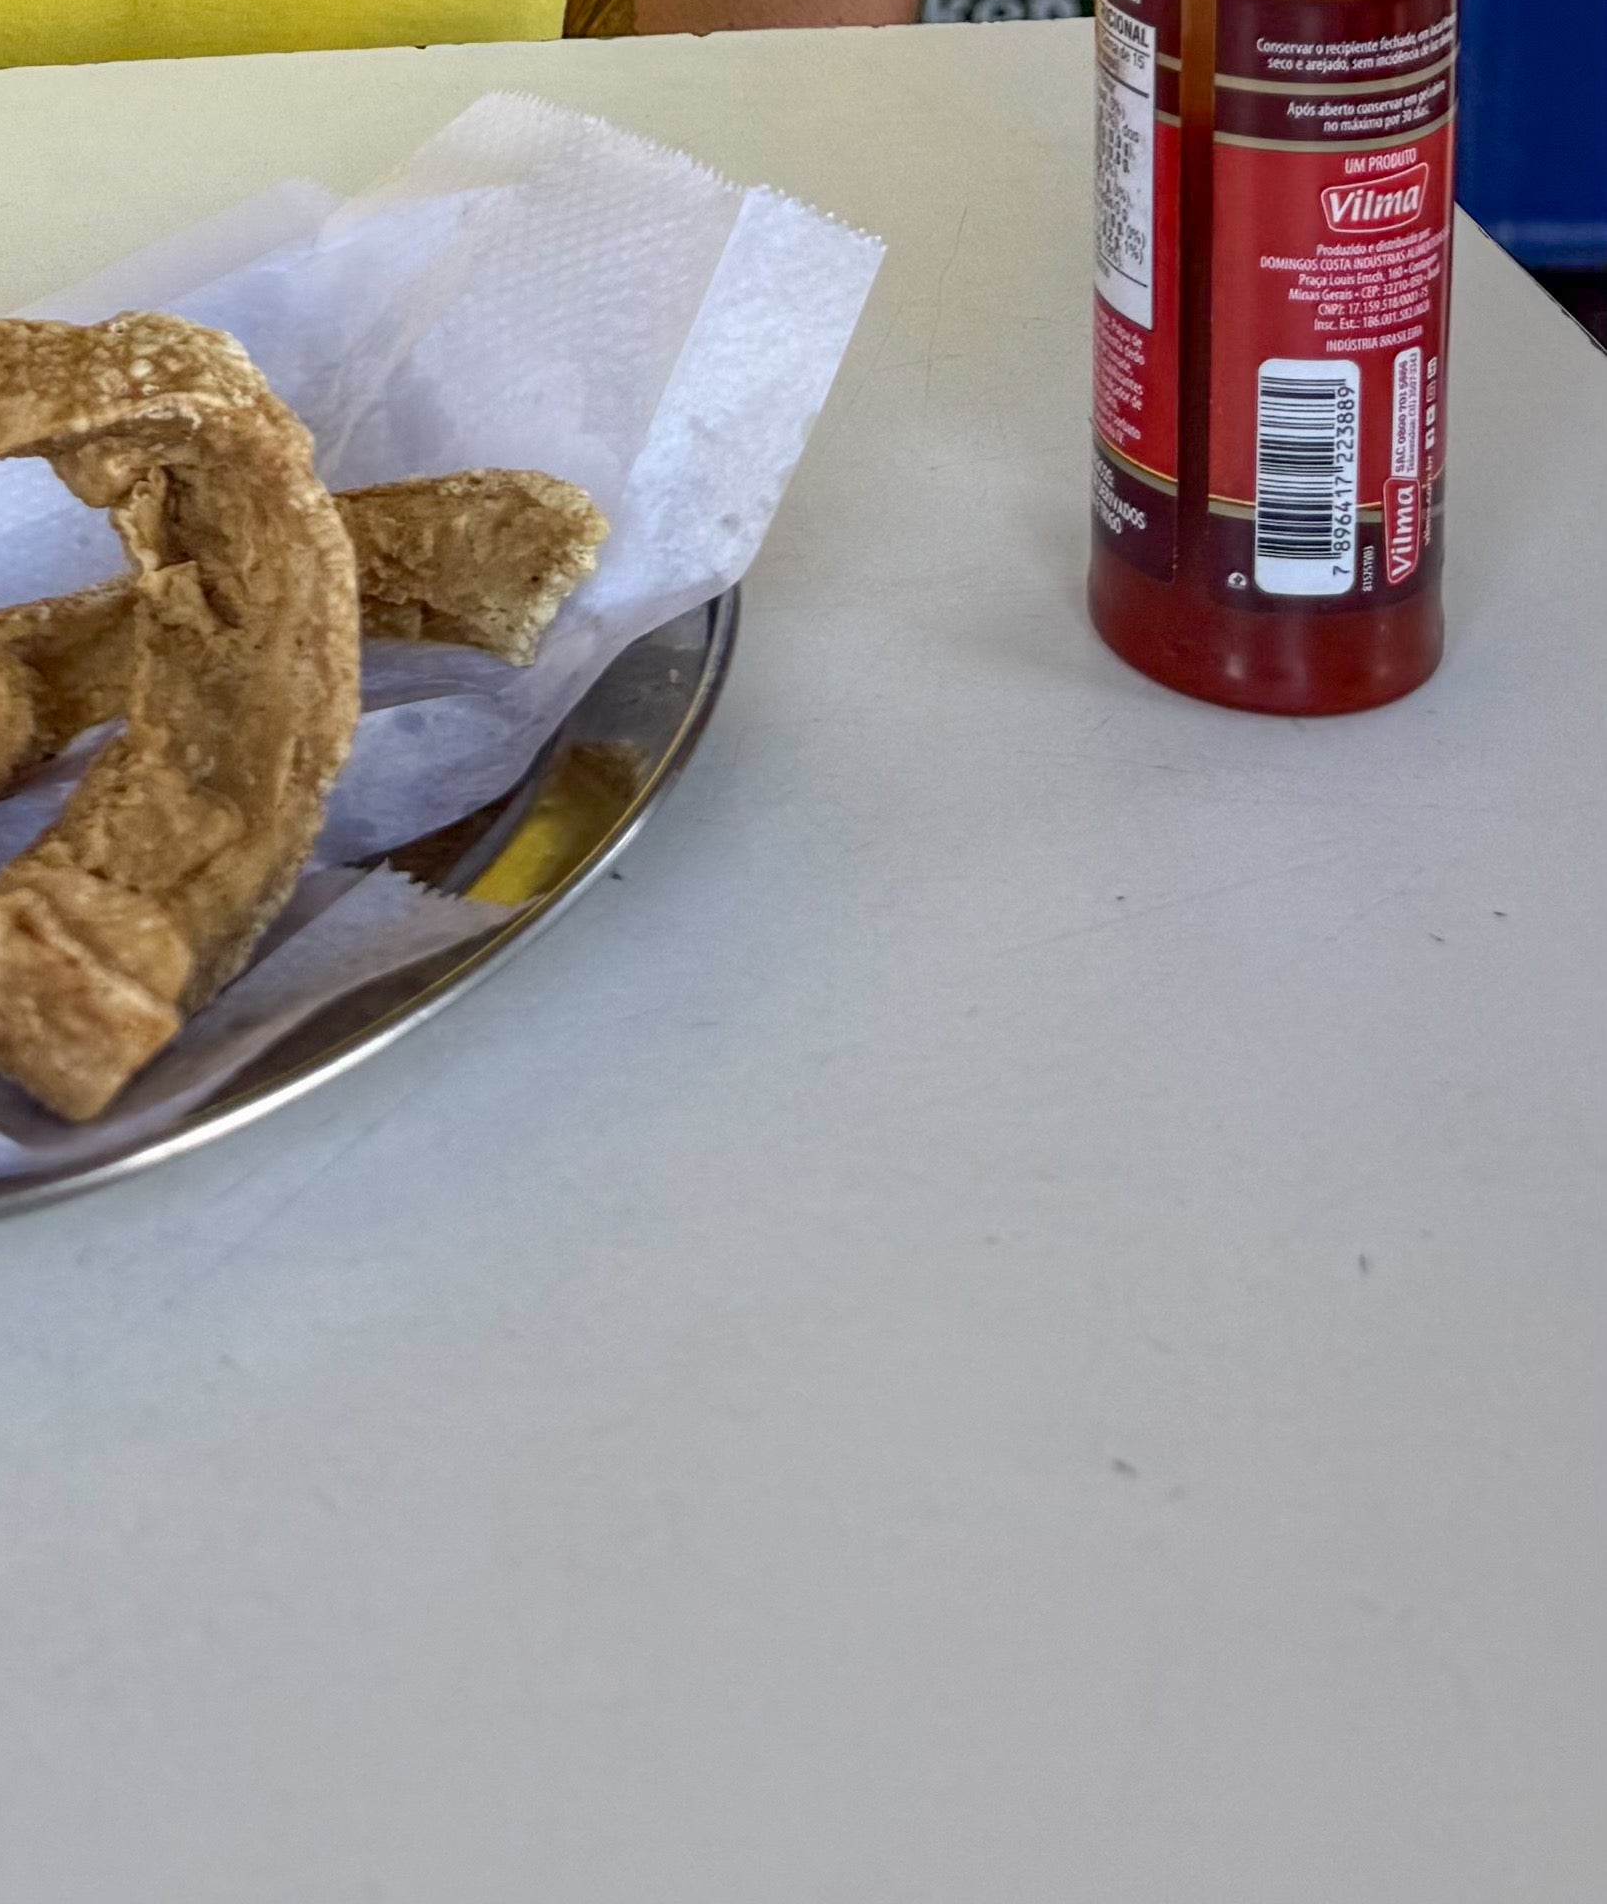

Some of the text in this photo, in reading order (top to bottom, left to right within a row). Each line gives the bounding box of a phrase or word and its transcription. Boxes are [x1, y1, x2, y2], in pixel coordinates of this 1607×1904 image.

[1256, 37, 1314, 55] Conservar
[1316, 44, 1323, 55] o
[1325, 40, 1378, 56] recipiente
[1267, 58, 1293, 71] seco
[1295, 60, 1304, 71] e
[1305, 57, 1350, 74] arejado,
[1352, 57, 1375, 70] sem
[1286, 101, 1317, 119] Após
[1317, 102, 1355, 117] aberto
[1357, 97, 1404, 115] conservar
[1323, 119, 1338, 132] no
[1340, 112, 1384, 132] máximo
[1345, 148, 1417, 174] UM PRODUTO
[1329, 184, 1421, 224] Vilma
[1316, 241, 1368, 256] Produzido
[1260, 255, 1318, 271] DOMINGOS
[1319, 257, 1352, 271] COSTA
[1298, 273, 1327, 288] Praça
[1329, 273, 1356, 286] Louis
[1288, 288, 1320, 301] Minas
[1321, 288, 1353, 301] Gerais
[1333, 386, 1356, 577] 7 896417 223889
[1391, 485, 1415, 578] Vilma
